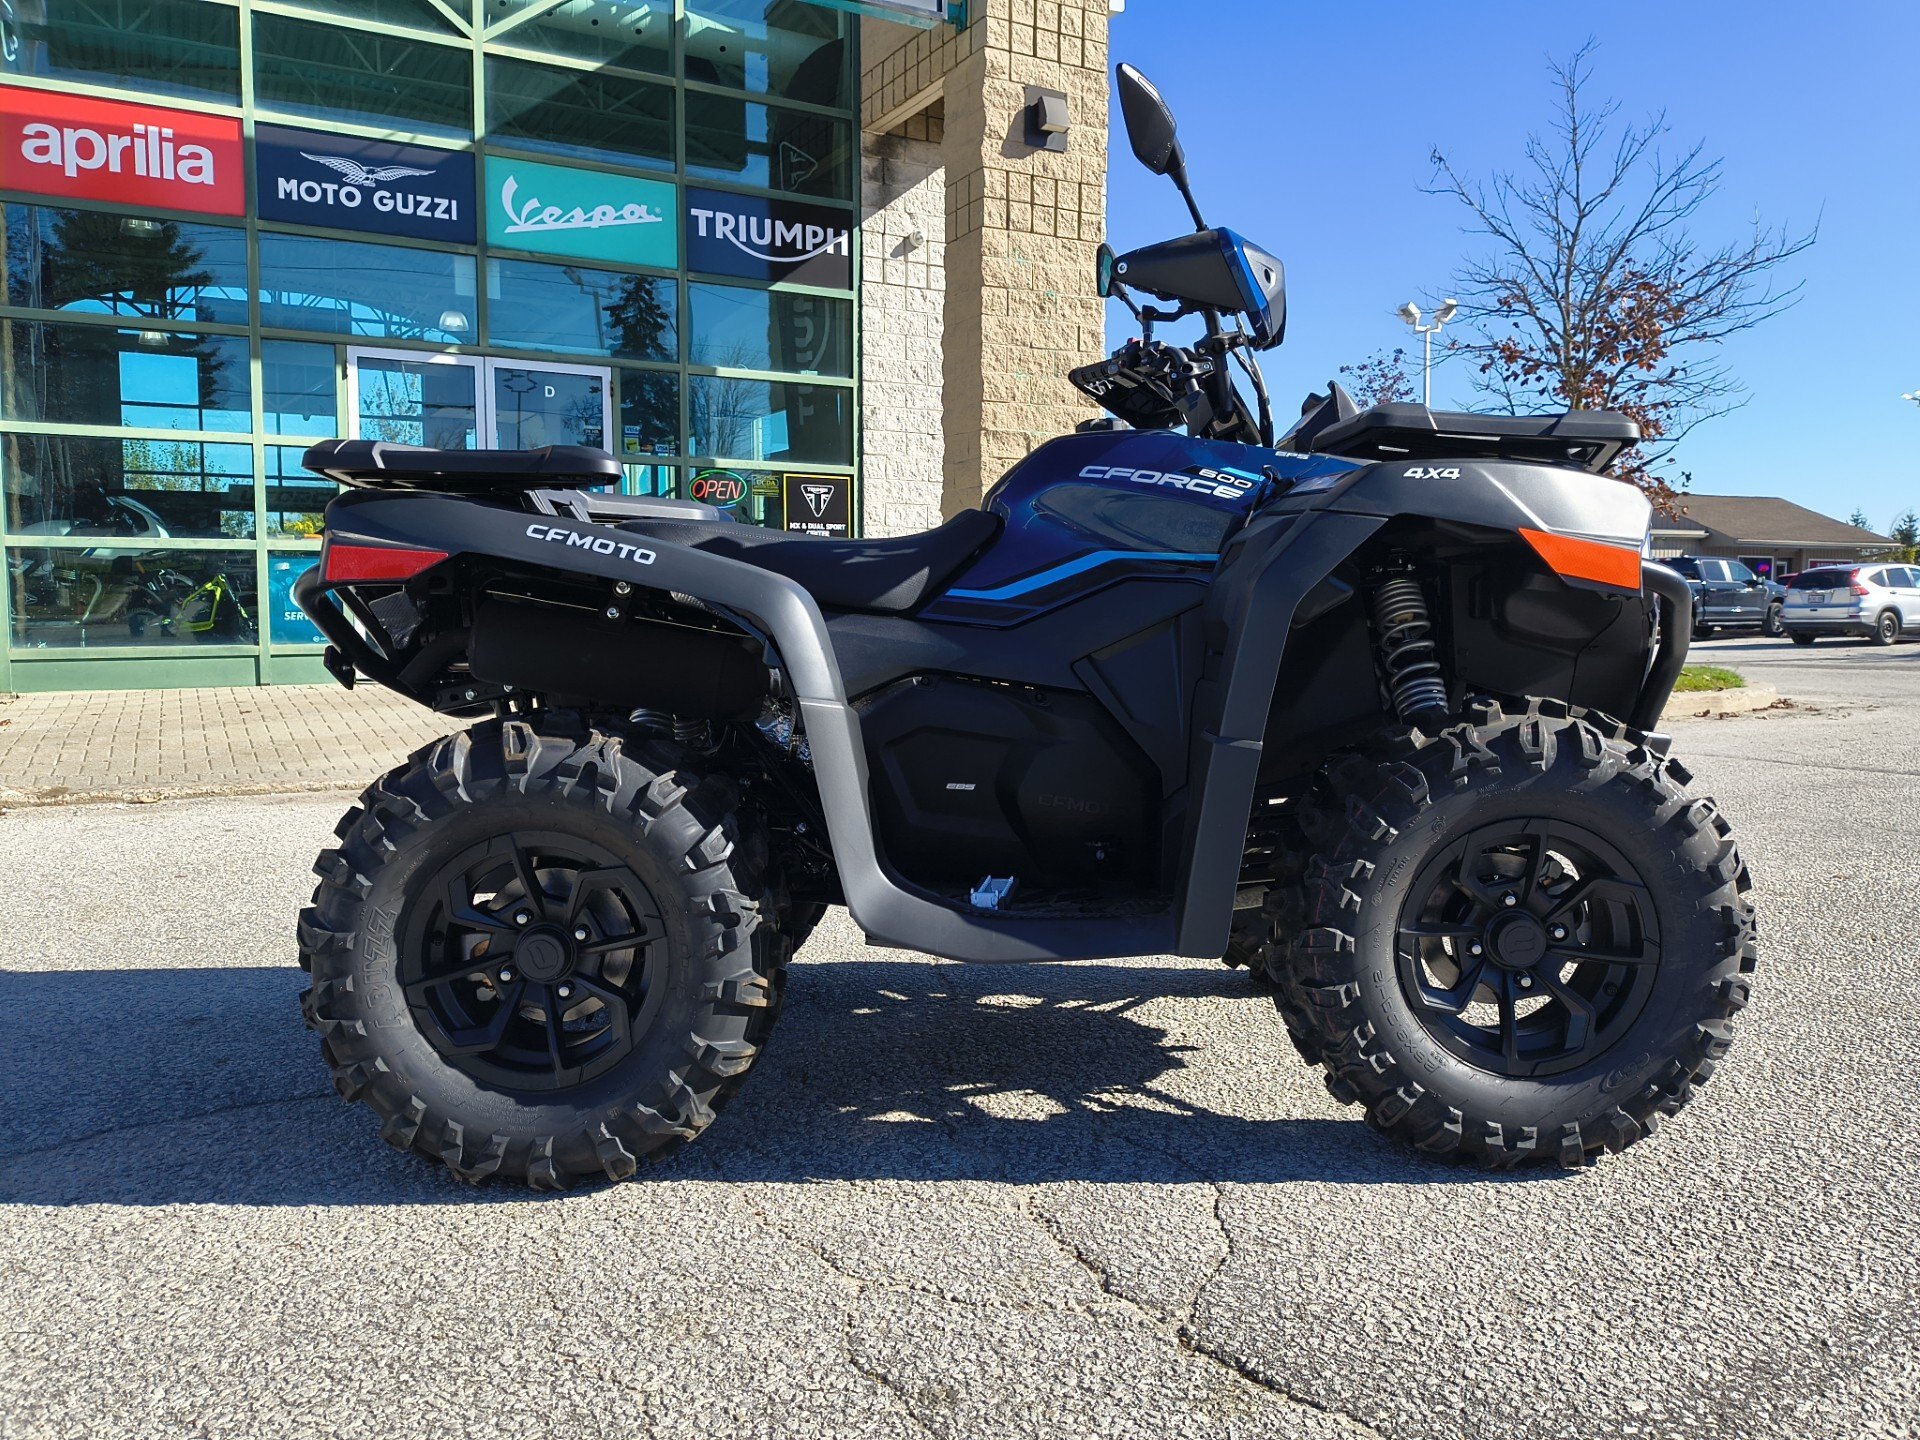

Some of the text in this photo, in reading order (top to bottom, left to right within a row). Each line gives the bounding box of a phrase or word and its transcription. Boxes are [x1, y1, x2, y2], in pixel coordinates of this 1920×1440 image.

[21, 123, 214, 185] aprilia
[277, 177, 458, 221] MOTO GUZZI
[501, 175, 662, 233] Vespa
[690, 208, 848, 262] TRIUMPH
[544, 385, 555, 398] D
[692, 480, 742, 499] OPEN
[1078, 465, 1245, 500] CFORCE
[1198, 468, 1253, 489] 600
[1403, 467, 1461, 480] 4X4
[525, 523, 657, 566] CFMOTO
[826, 523, 847, 531] SPORT
